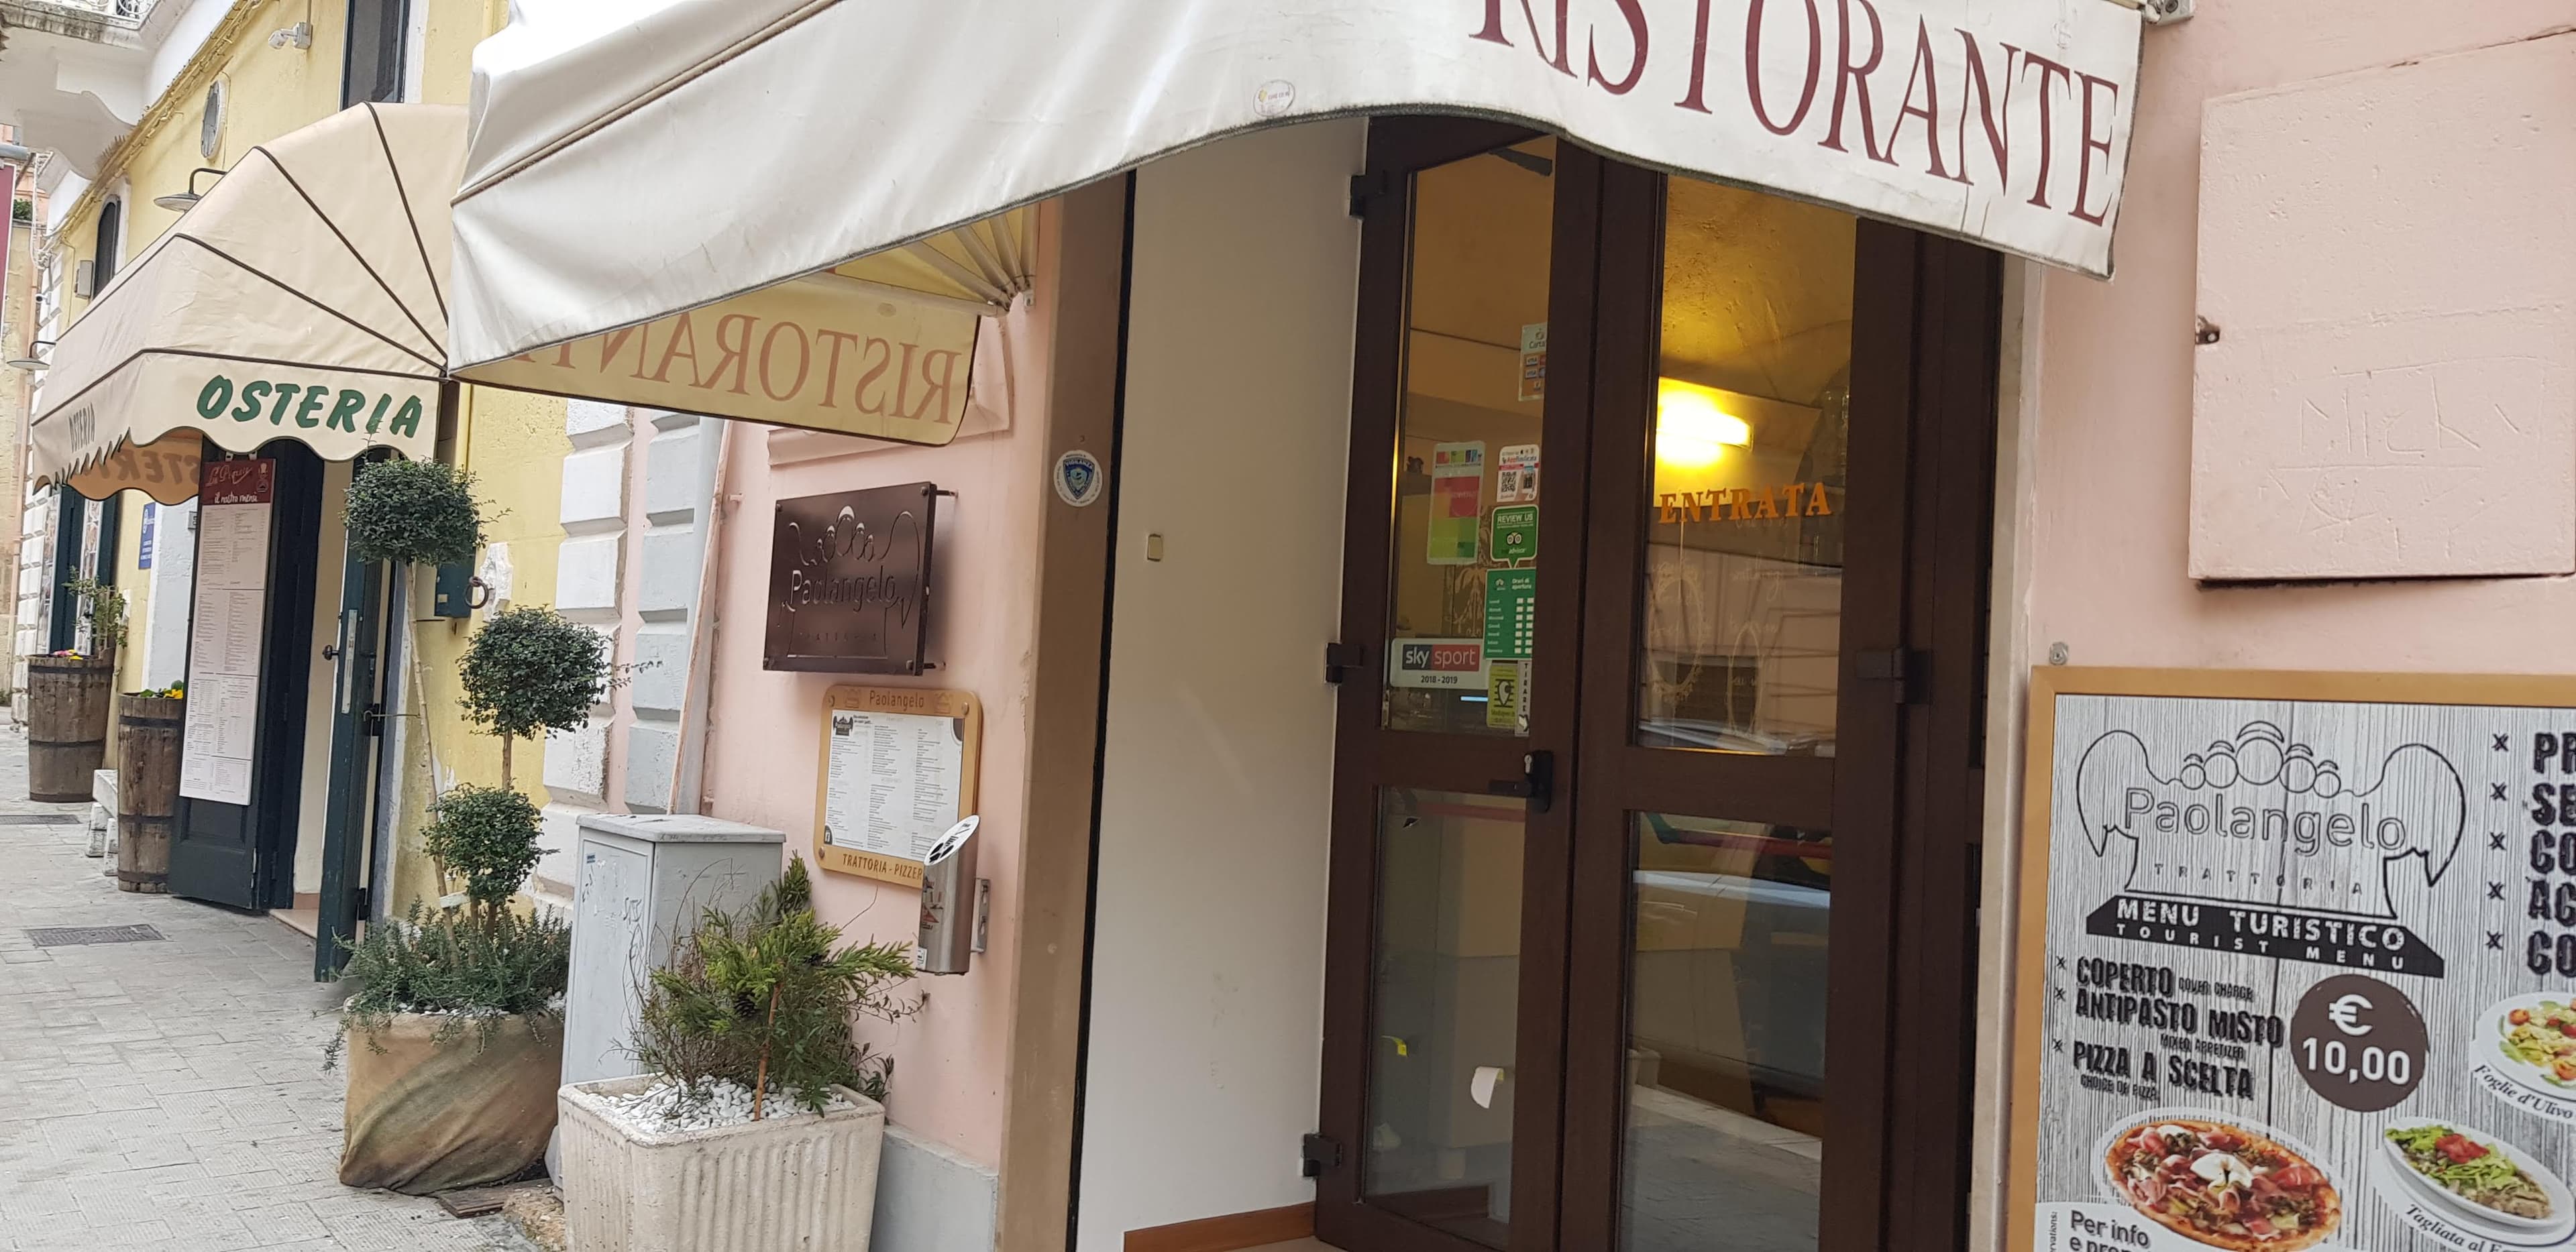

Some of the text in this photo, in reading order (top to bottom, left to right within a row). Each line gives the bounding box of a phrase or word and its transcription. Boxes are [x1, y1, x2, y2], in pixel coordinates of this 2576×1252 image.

[197, 375, 423, 438] OSTERIA
[1497, 512, 1534, 523] REVIEW US
[1658, 482, 1832, 524] ENTRATA
[790, 565, 896, 613] Paolangelo
[1405, 646, 1477, 669] sky sport
[1421, 675, 1436, 683] 2018
[869, 690, 924, 711] Paolangelo
[2125, 787, 2406, 857] Paolangelo
[843, 854, 887, 873] TRATTORIA
[2154, 863, 2362, 895] TRATTORIA
[2116, 898, 2406, 952] MENU TURISTICO
[2116, 924, 2404, 970] TOURIST MENU
[2077, 956, 2253, 1002] COPERTO COVER CHARGE
[2076, 988, 2284, 1047] ANTIPASTO MISTO
[2328, 994, 2373, 1036] €
[2161, 1034, 2246, 1060] MIXED APPETIZER
[2303, 1037, 2410, 1085] 10,00
[2074, 1041, 2254, 1100] PIZZA A SCELTA
[2080, 1074, 2114, 1093] CHOICE
[2474, 1064, 2573, 1119] Foglie d'Ulivo
[2070, 1236, 2082, 1251] e
[2071, 1210, 2151, 1248] Per info
[2406, 1204, 2465, 1247] Tagliata
